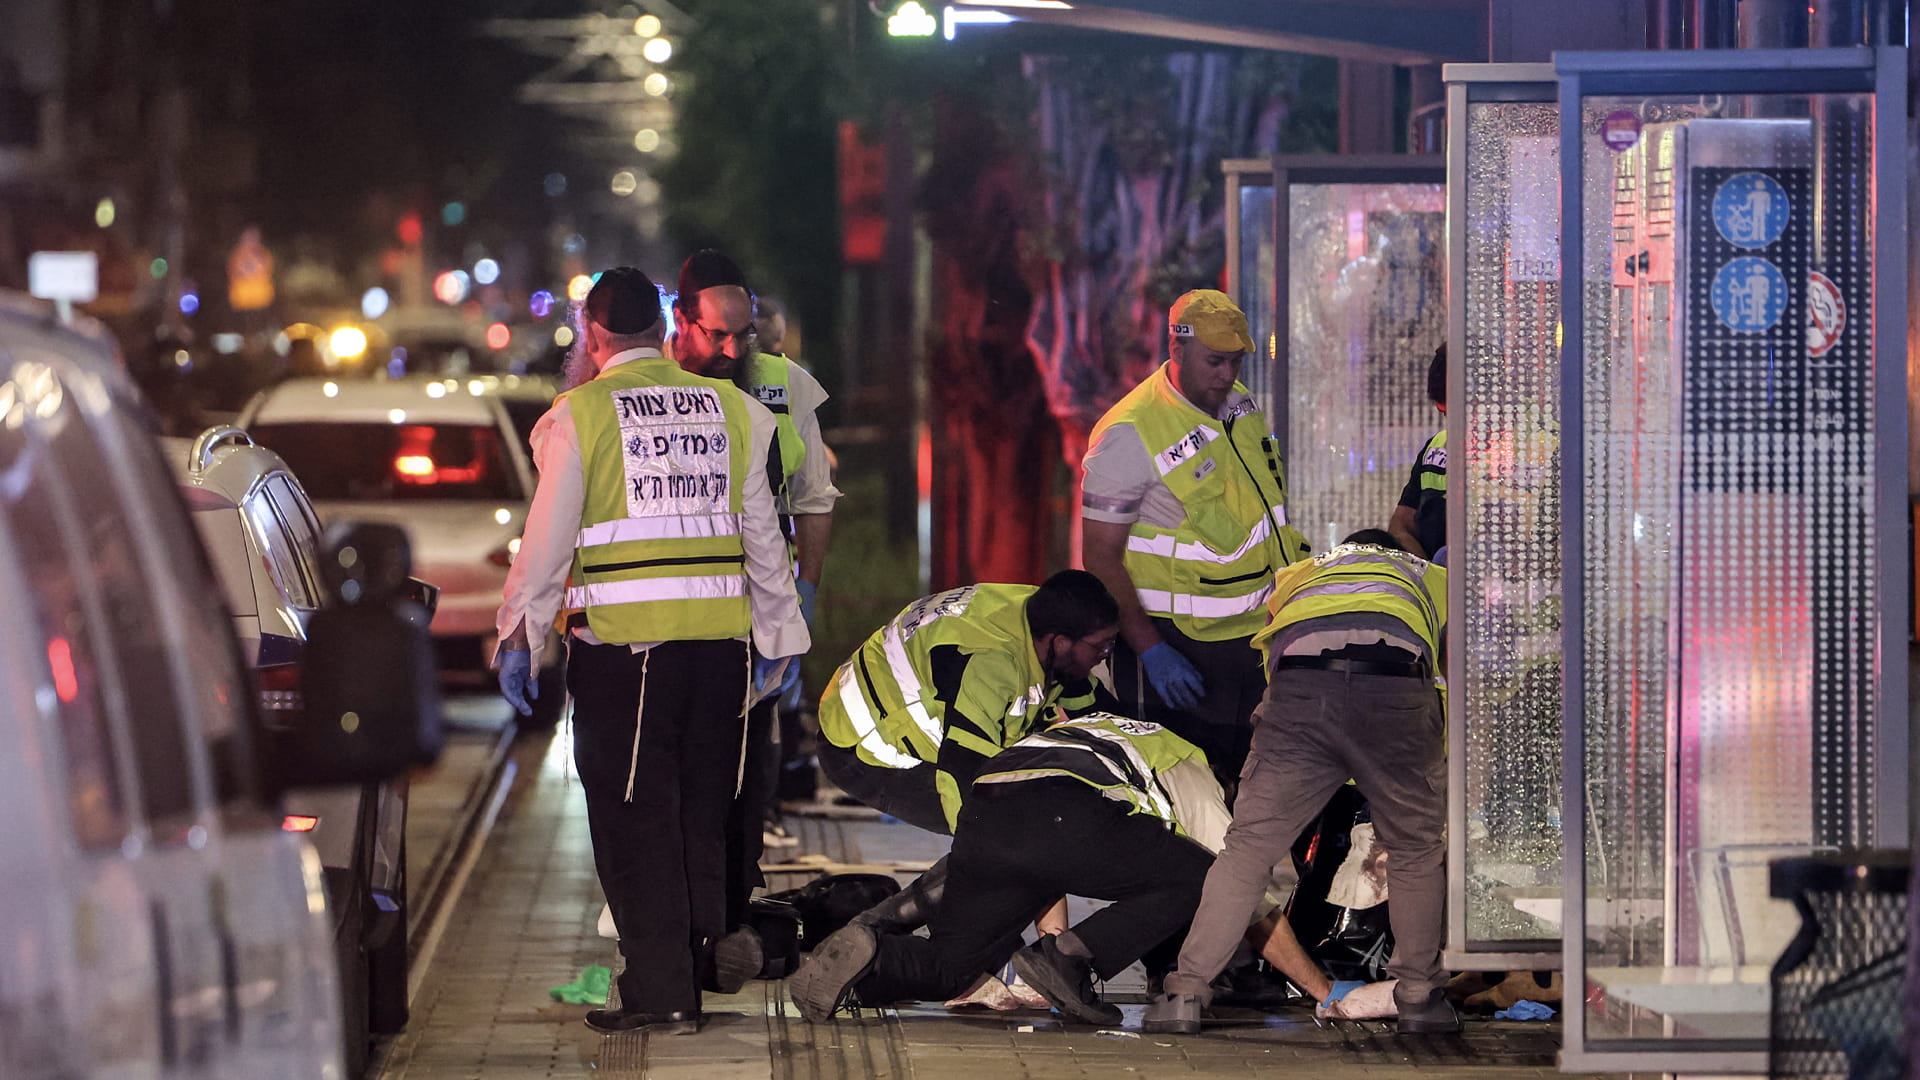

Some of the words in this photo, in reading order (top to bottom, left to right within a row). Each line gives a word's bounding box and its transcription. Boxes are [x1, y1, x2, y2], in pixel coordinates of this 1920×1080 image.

[618, 394, 668, 419] צוות
[672, 391, 720, 415] ראש
[653, 432, 708, 457] מז"פ
[1168, 430, 1204, 462] זק"א
[632, 475, 663, 501] ת"א
[667, 474, 697, 498] מחוז
[699, 471, 728, 504] זק"א
